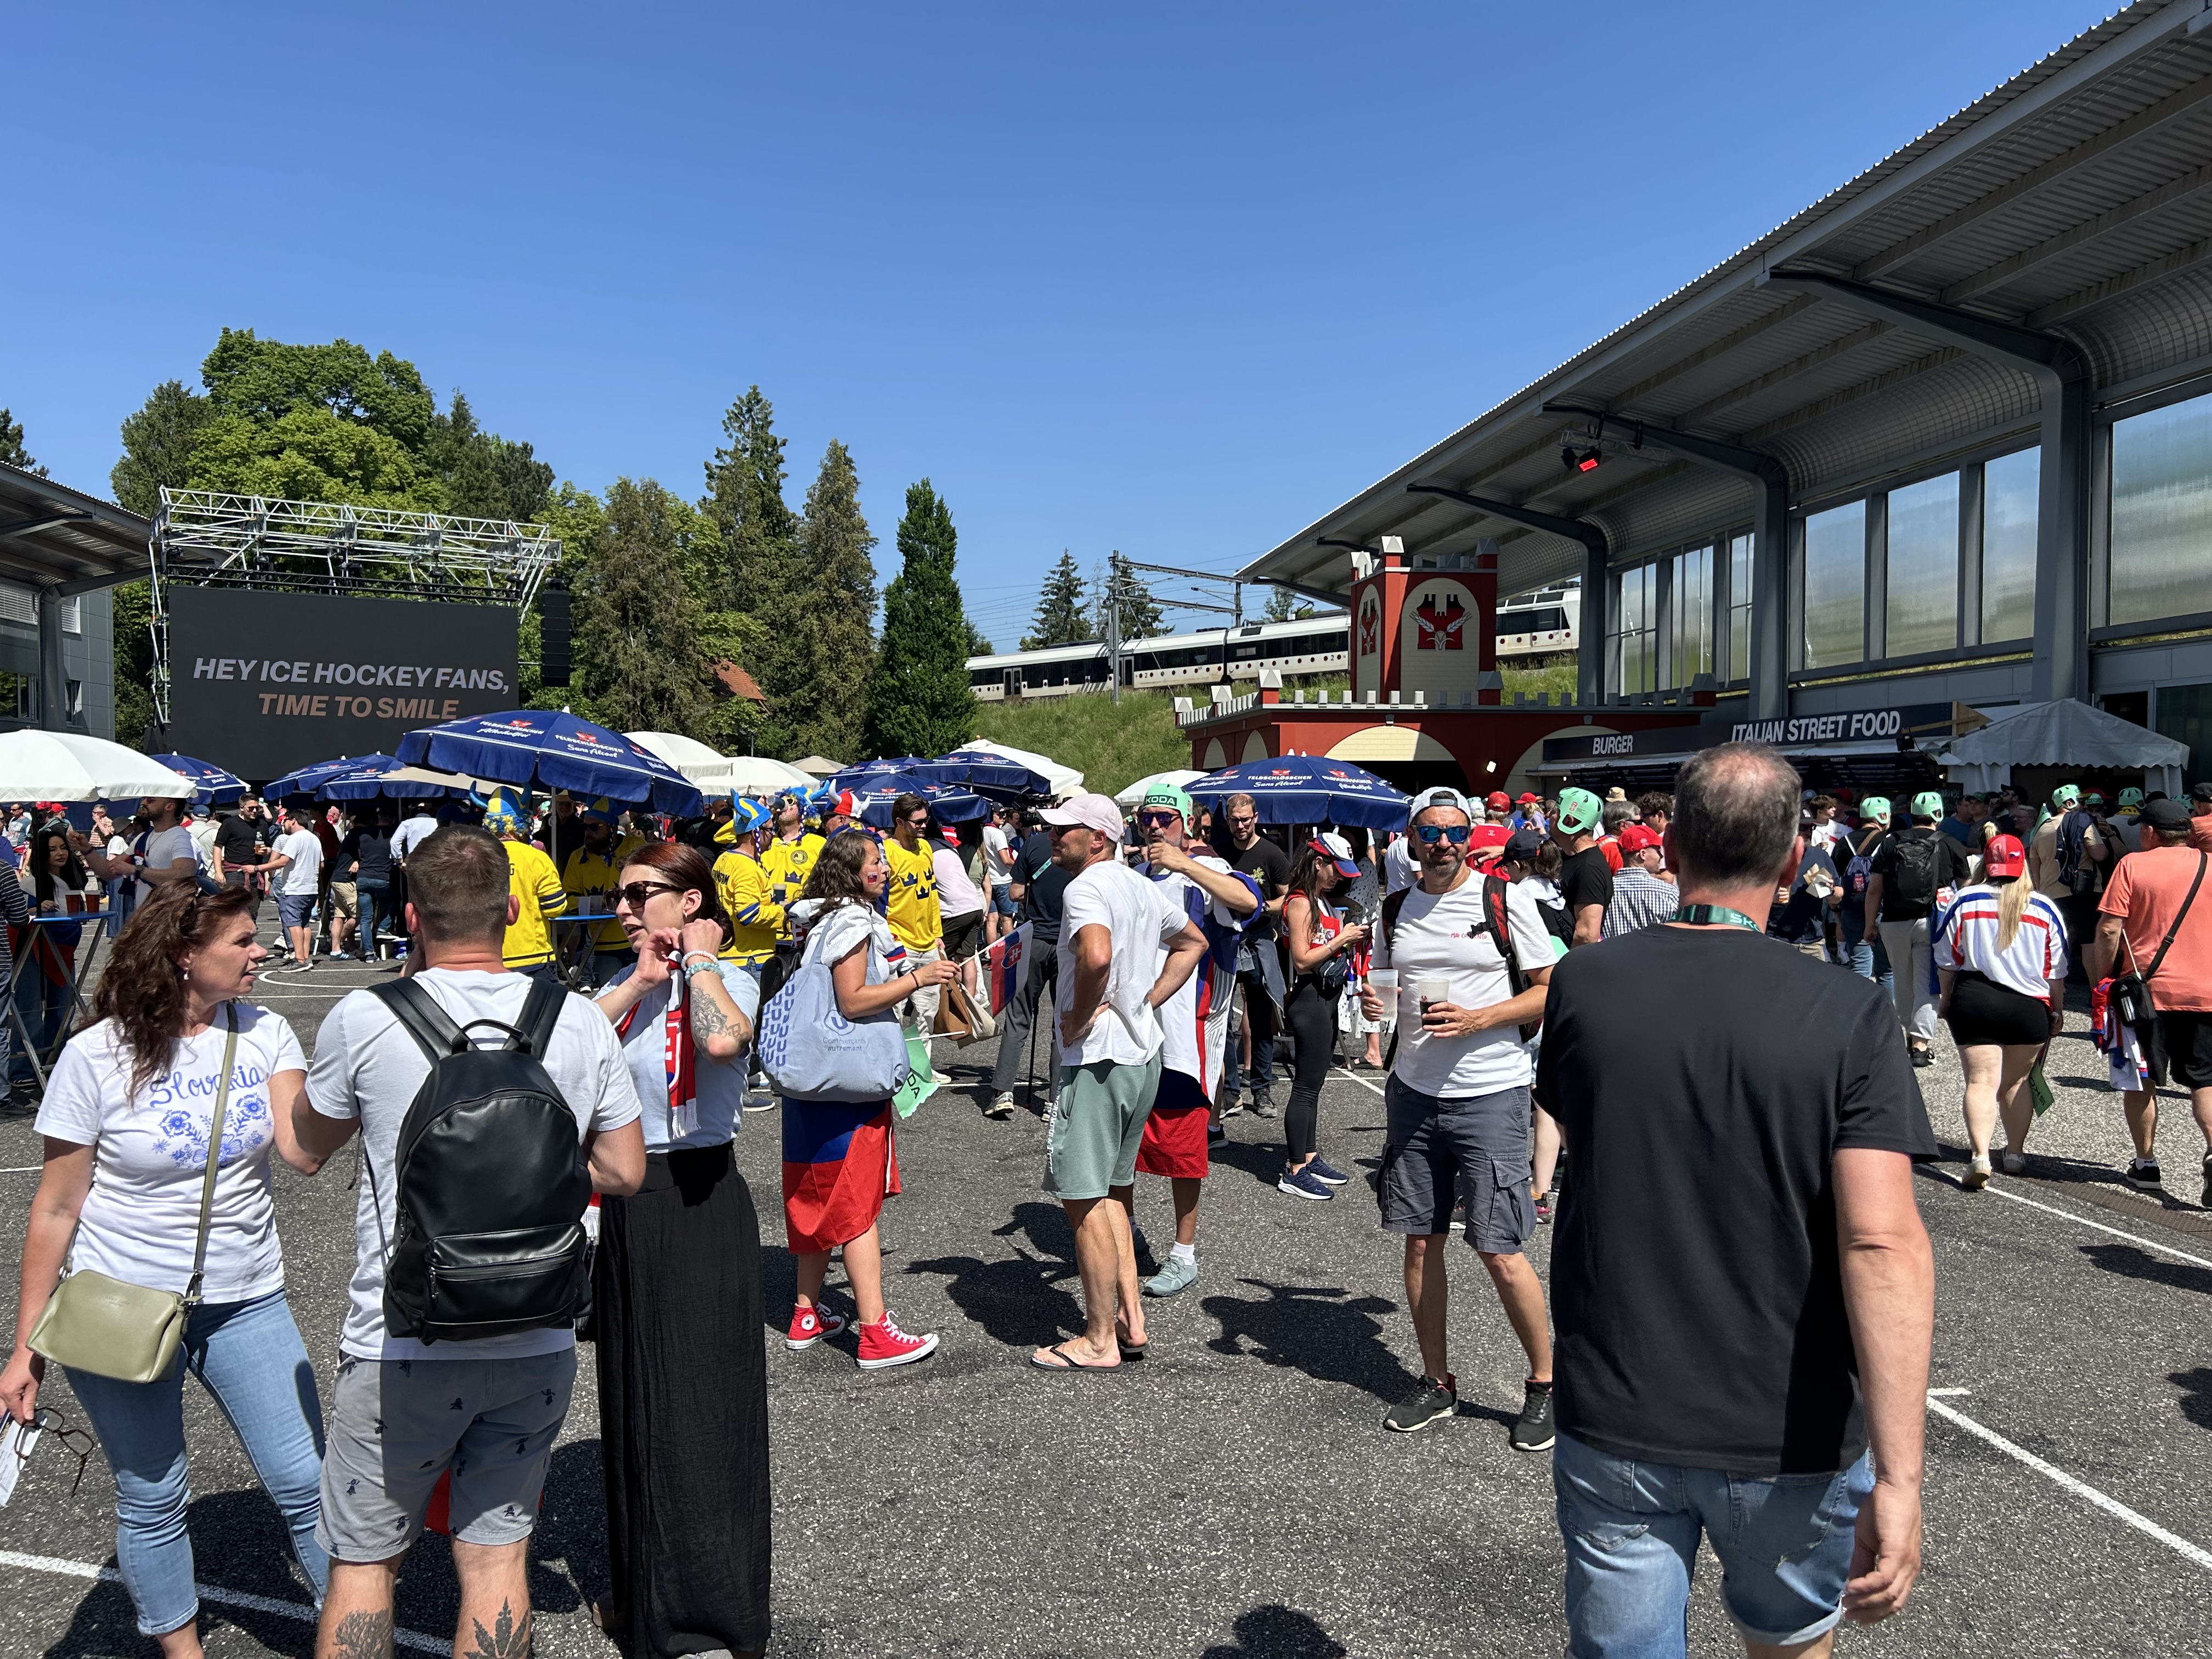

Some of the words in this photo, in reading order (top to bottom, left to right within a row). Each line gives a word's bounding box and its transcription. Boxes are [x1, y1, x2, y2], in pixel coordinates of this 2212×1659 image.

[193, 658, 259, 680] HEY
[260, 661, 311, 683] ICE
[313, 663, 433, 688] HOCKEY
[435, 667, 509, 694] FANS,
[258, 693, 329, 716] TIME
[334, 696, 373, 718] TO
[375, 698, 459, 720] SMILE
[1731, 720, 1785, 742] ITALIAN
[1787, 715, 1847, 742] STREET
[1849, 710, 1900, 737] FOOD
[567, 743, 589, 754] Sans
[589, 748, 618, 758] Alcool
[1592, 735, 1634, 755] BURGER
[1145, 796, 1176, 805] KODA
[785, 984, 795, 996] U
[772, 994, 782, 1006] U
[785, 999, 794, 1011] U
[763, 1004, 770, 1015] U
[771, 1008, 782, 1021] U
[761, 1018, 769, 1030] U
[770, 1023, 781, 1035] U
[831, 1016, 849, 1030] U
[779, 1025, 789, 1038] U
[759, 1032, 768, 1046] U
[767, 1036, 776, 1049] U
[777, 1039, 787, 1052] U
[766, 1050, 774, 1064] U
[776, 1054, 786, 1067] U
